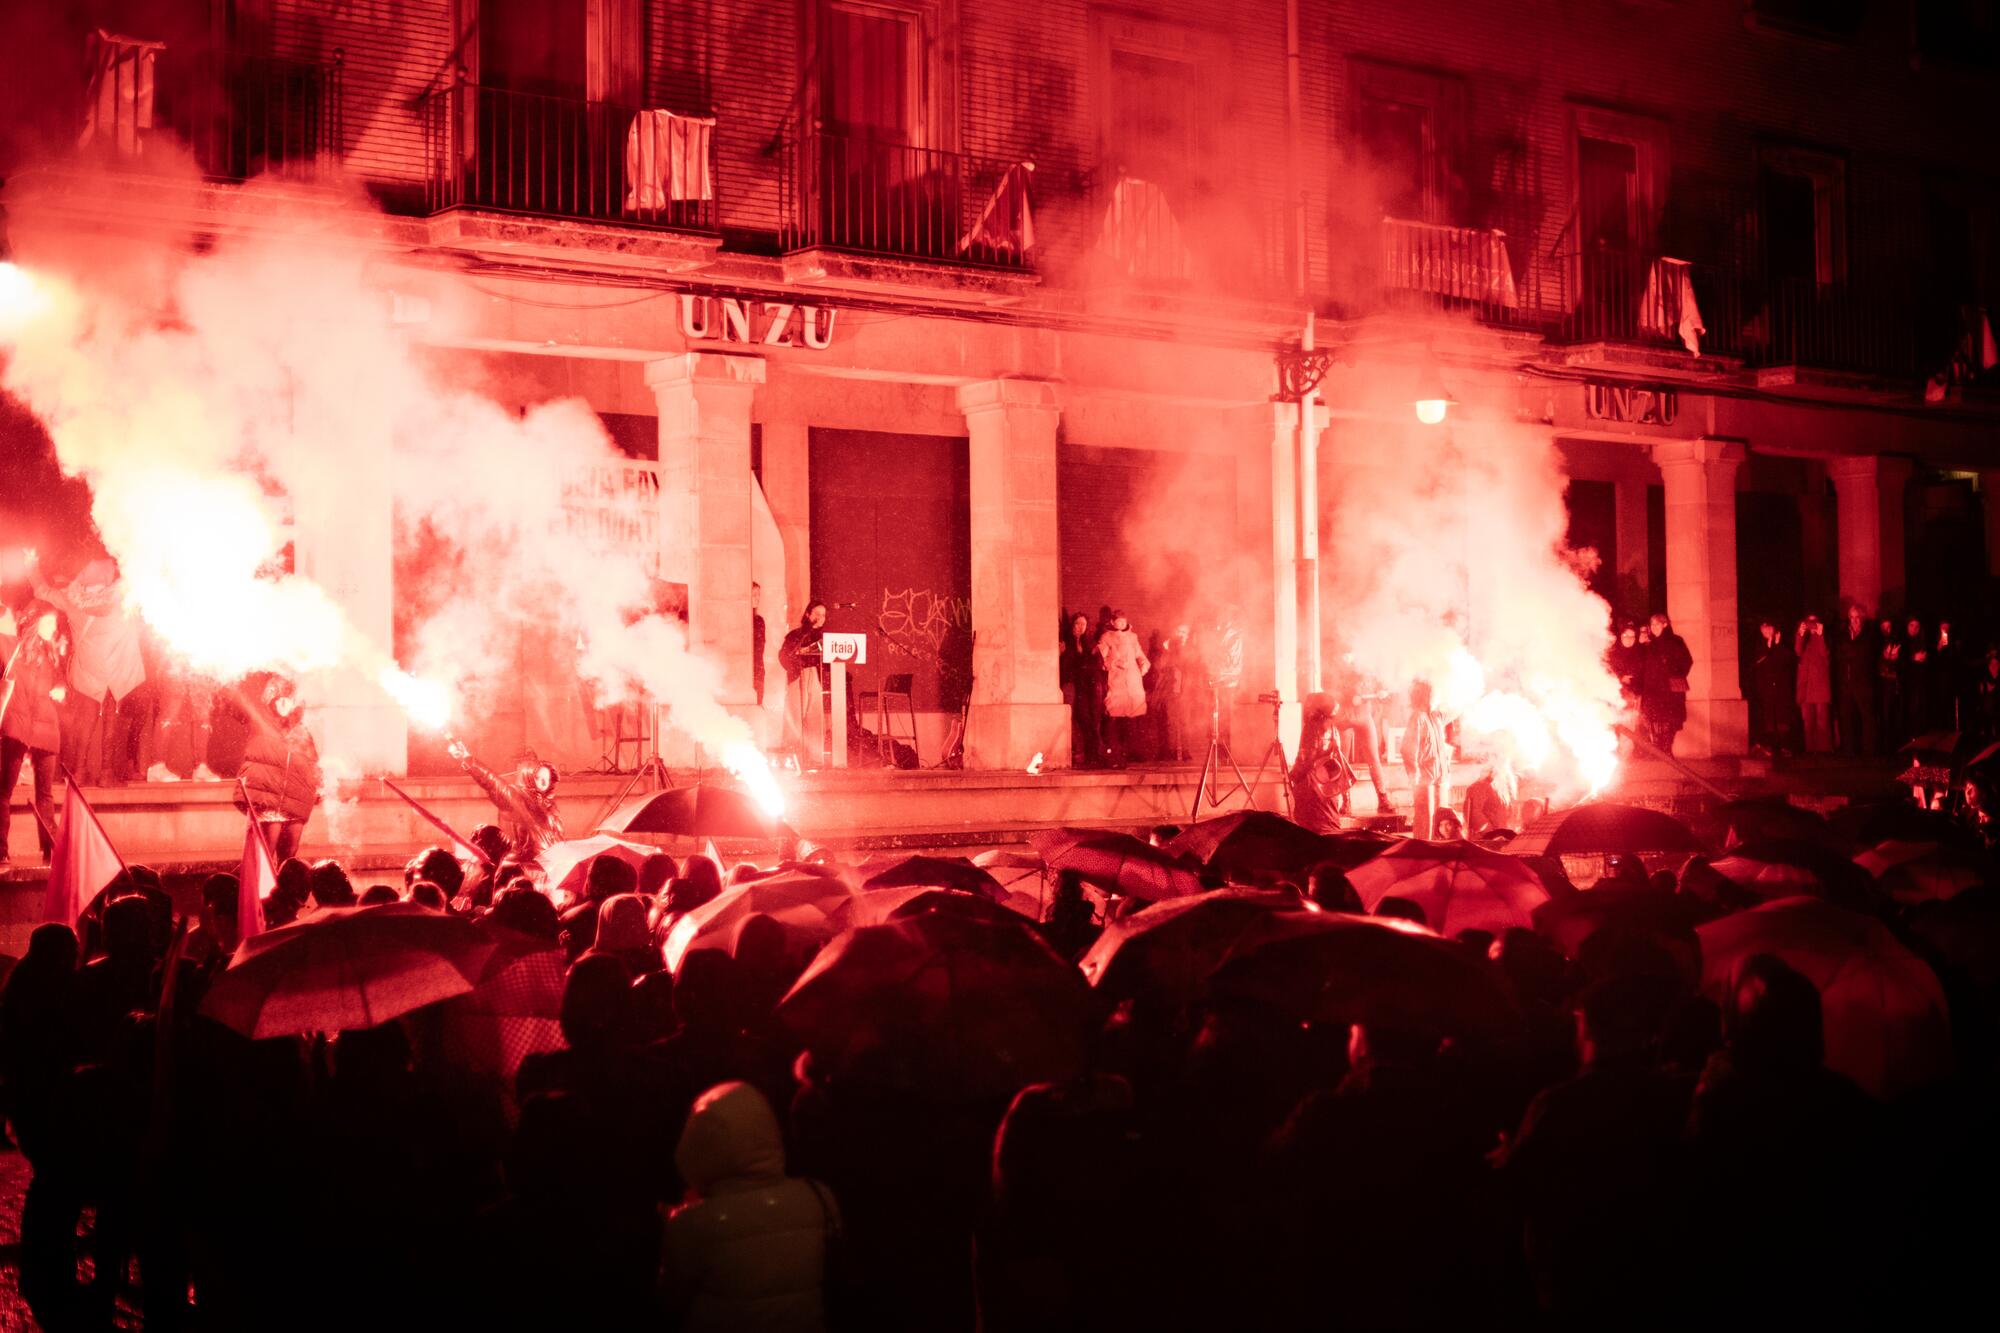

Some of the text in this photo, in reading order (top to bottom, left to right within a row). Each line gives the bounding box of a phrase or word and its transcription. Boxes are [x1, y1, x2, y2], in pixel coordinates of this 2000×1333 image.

[1386, 250, 1515, 294] ELKARBIZTZA
[678, 293, 837, 350] UNZU
[1587, 384, 1677, 426] UNZU
[831, 641, 853, 654] itaia
